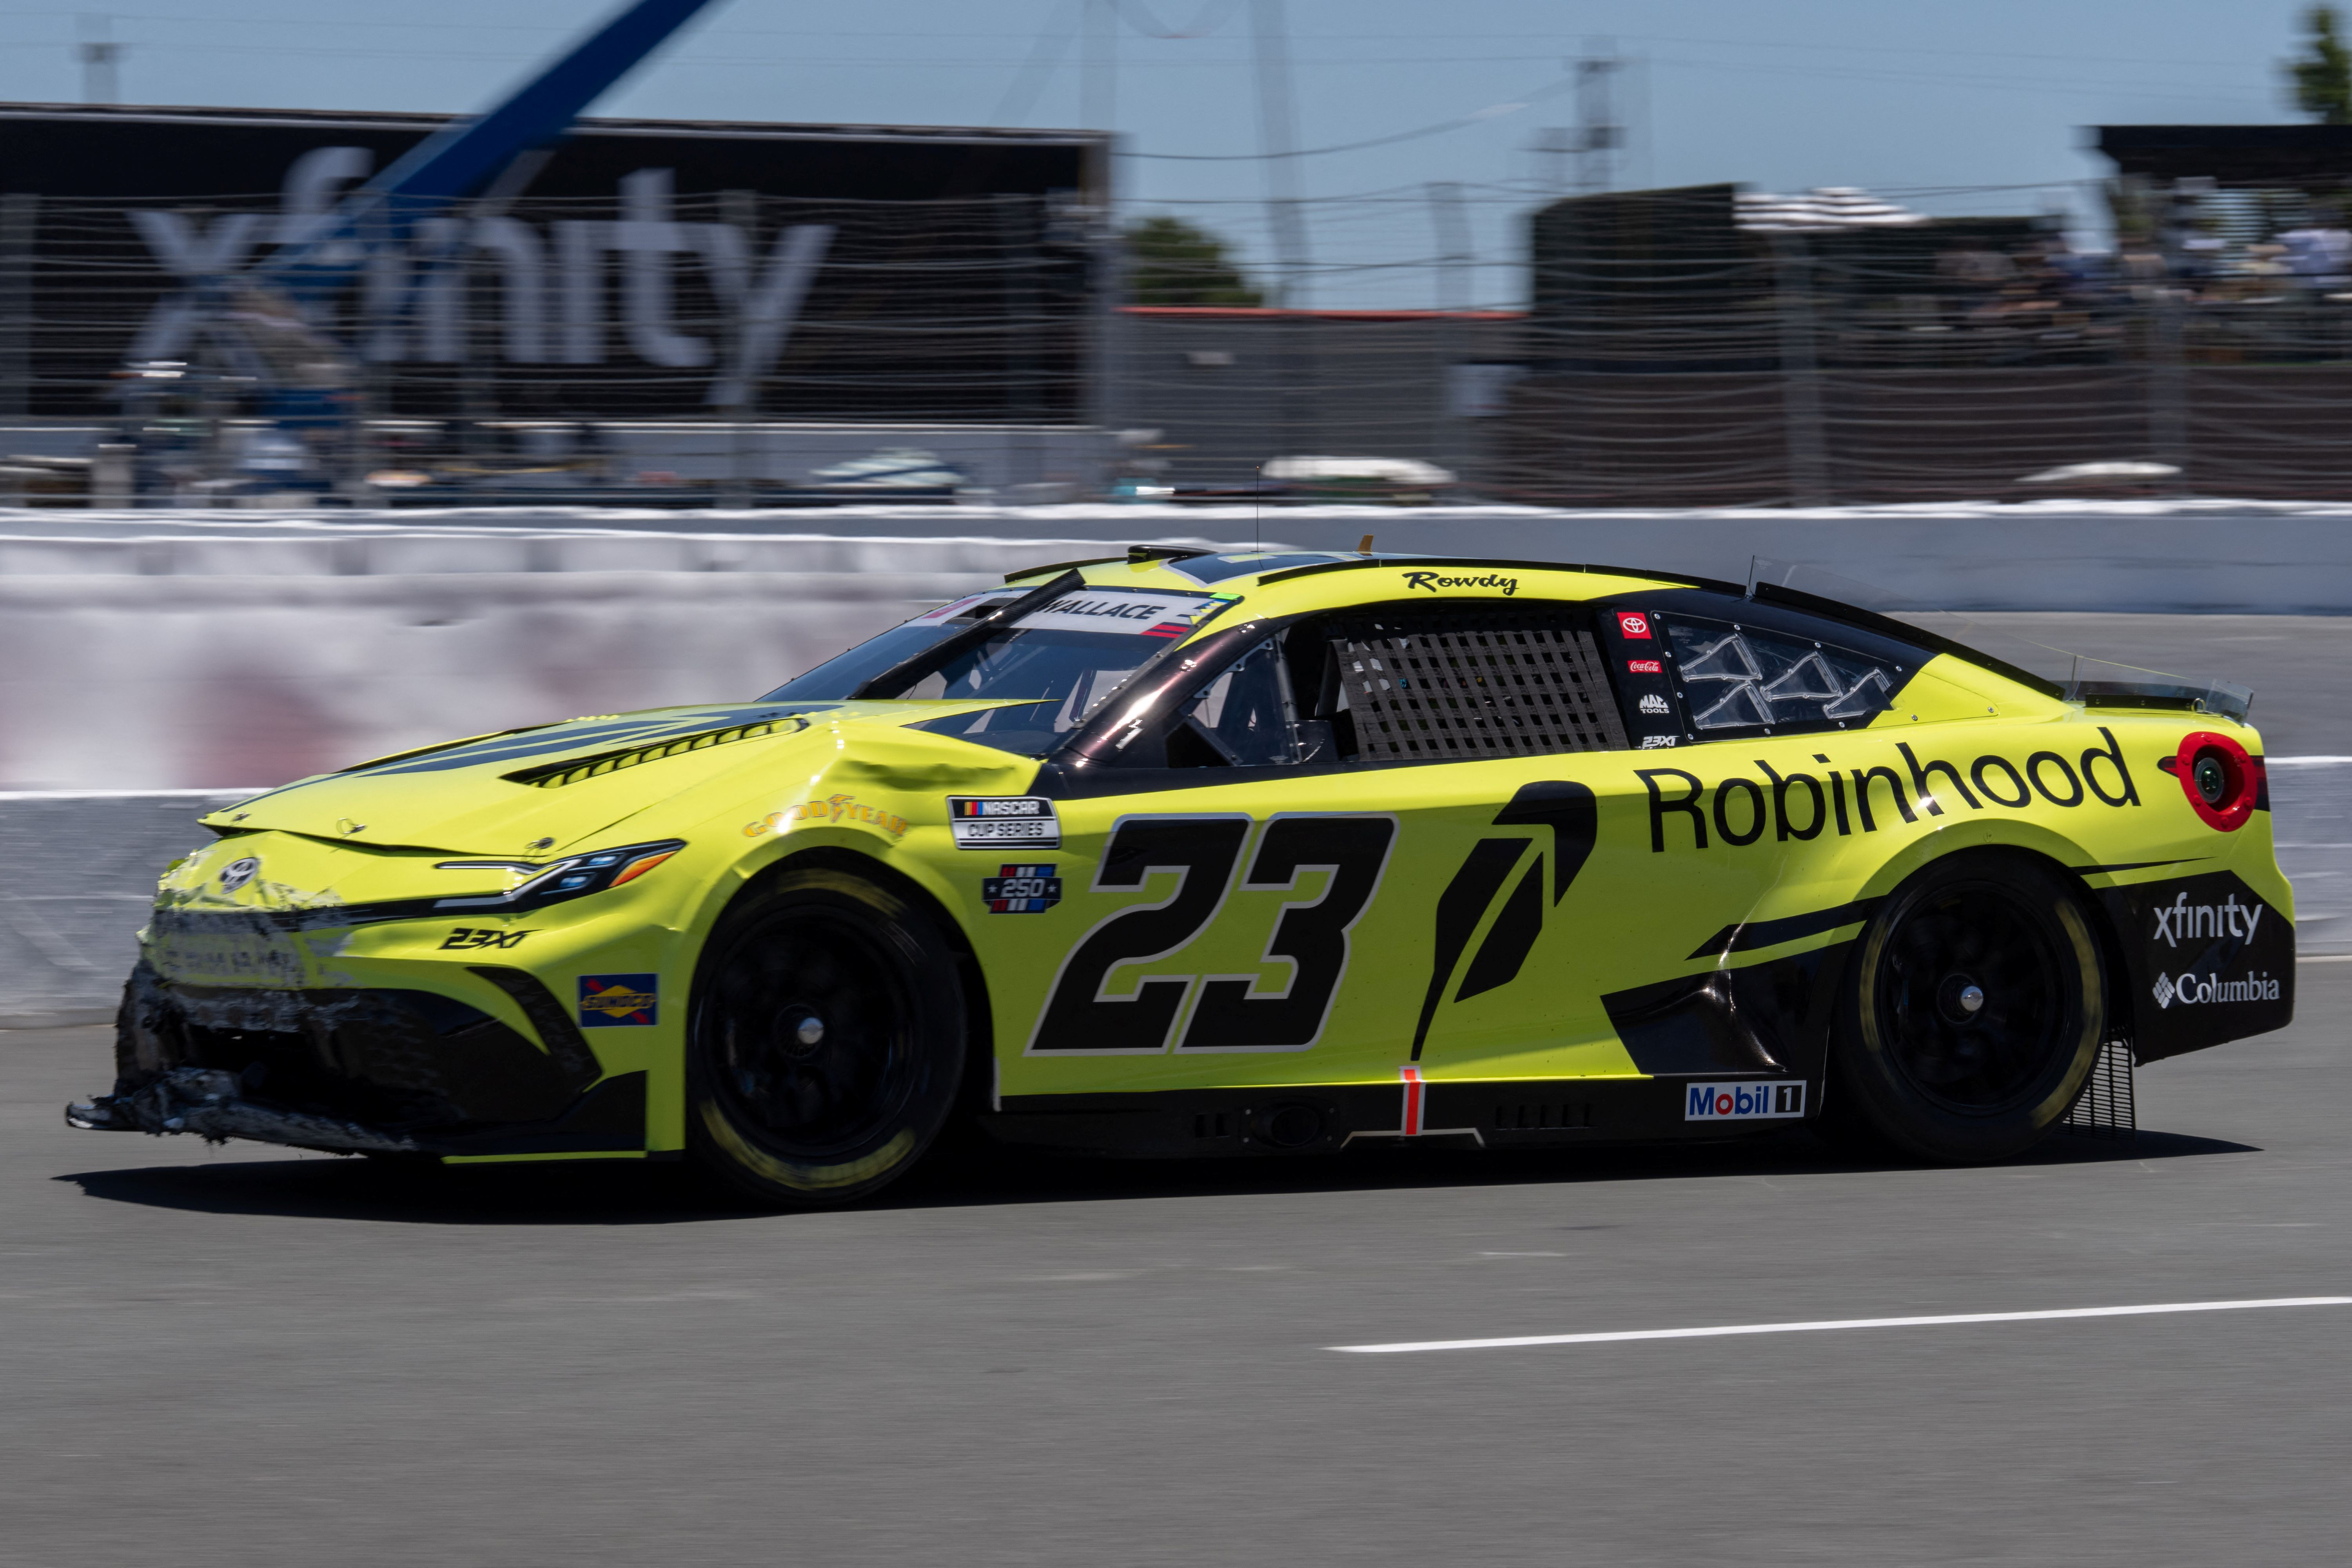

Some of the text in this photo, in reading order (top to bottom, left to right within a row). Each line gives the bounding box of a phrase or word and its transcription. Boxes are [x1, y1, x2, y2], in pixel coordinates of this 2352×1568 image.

[125, 147, 839, 406] xfinity
[1401, 571, 1520, 596] Rowdy
[1036, 600, 1167, 619] WALLACE
[1639, 694, 1668, 708] MAC
[1633, 726, 2141, 853] Robinhood
[742, 794, 908, 837] GOODYEAR
[983, 801, 1040, 815] NASCAR
[968, 823, 1044, 836] CUP SERIES
[1000, 878, 1046, 897] 250
[1022, 811, 1399, 1057] 23
[2153, 892, 2263, 947] xfinity
[2176, 971, 2280, 1004] Columbia
[1689, 1085, 1792, 1116] Mobil 1
